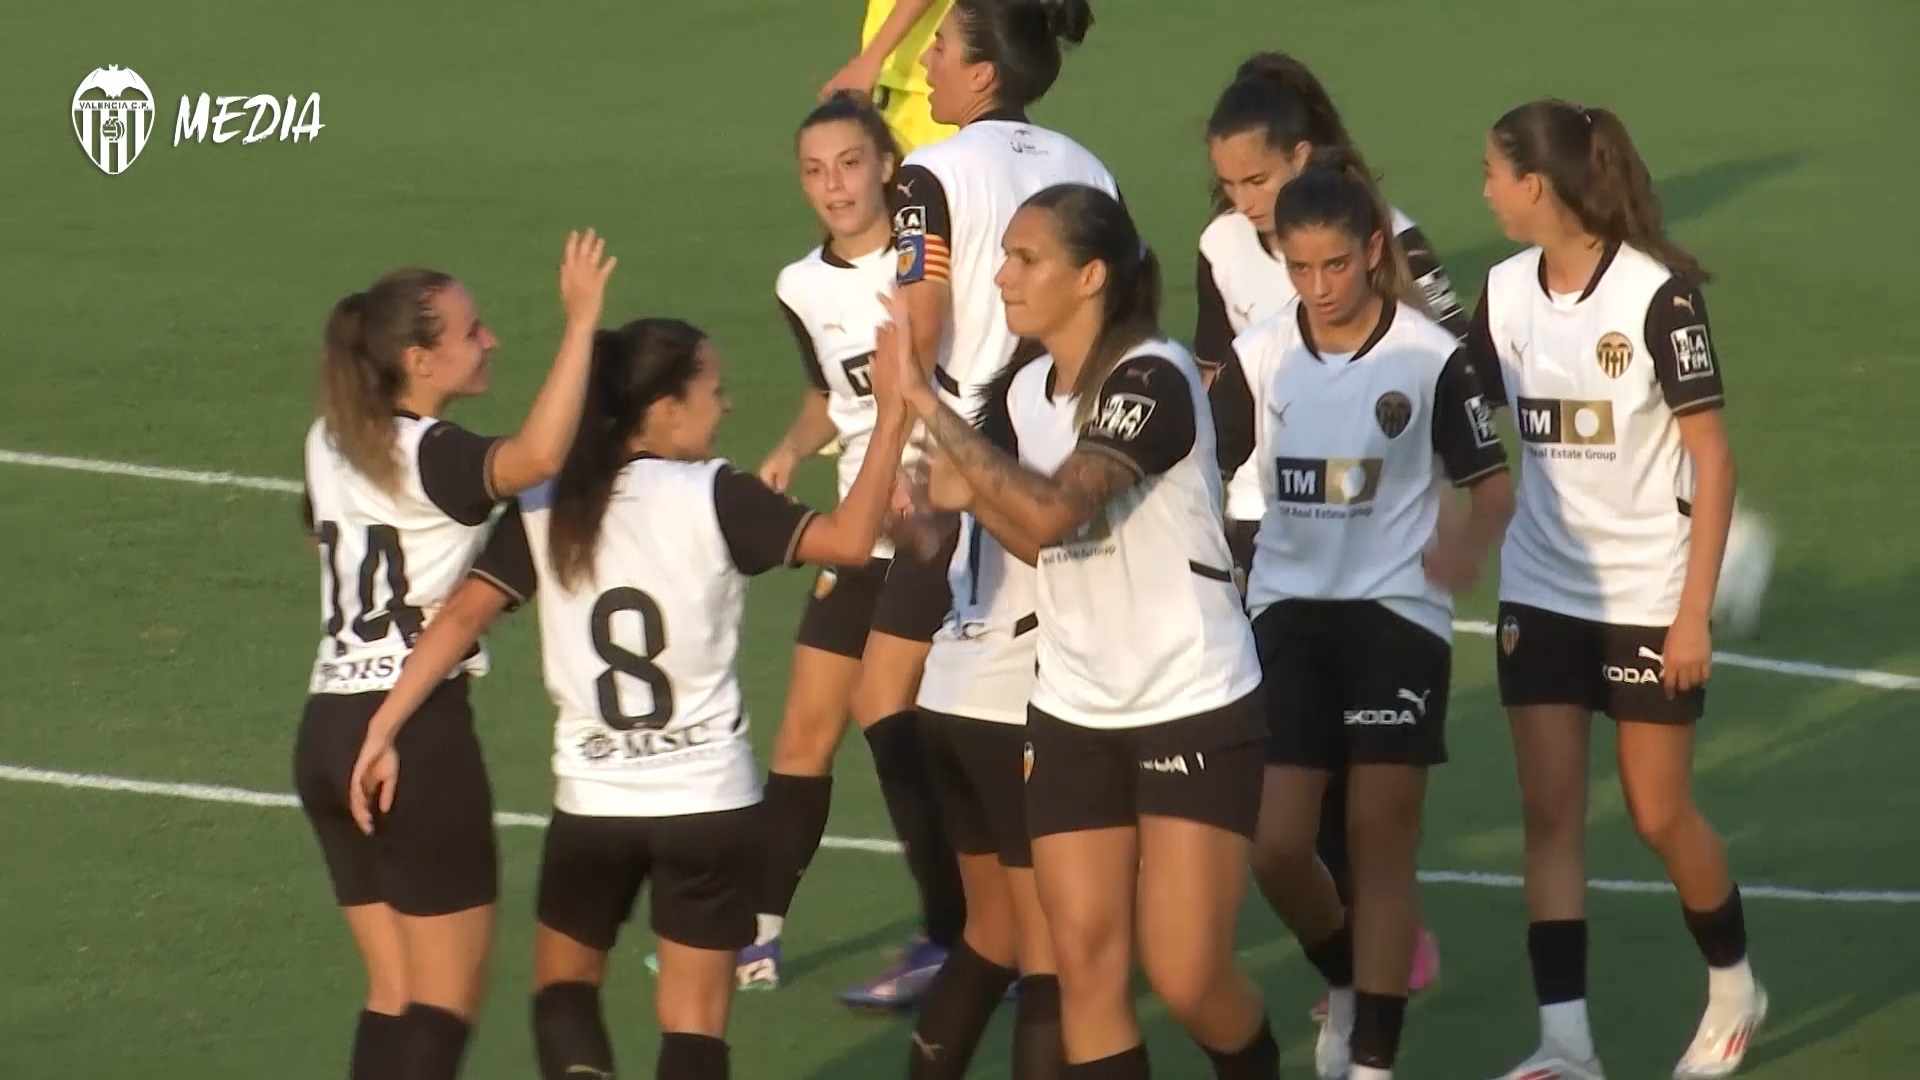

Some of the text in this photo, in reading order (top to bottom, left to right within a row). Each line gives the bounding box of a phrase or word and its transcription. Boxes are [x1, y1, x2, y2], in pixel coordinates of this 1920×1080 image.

[1520, 407, 1552, 436] TM
[1584, 448, 1617, 462] Group
[1281, 468, 1317, 496] TM
[320, 519, 425, 651] 14
[590, 586, 673, 732] 8
[623, 720, 708, 759] MSC
